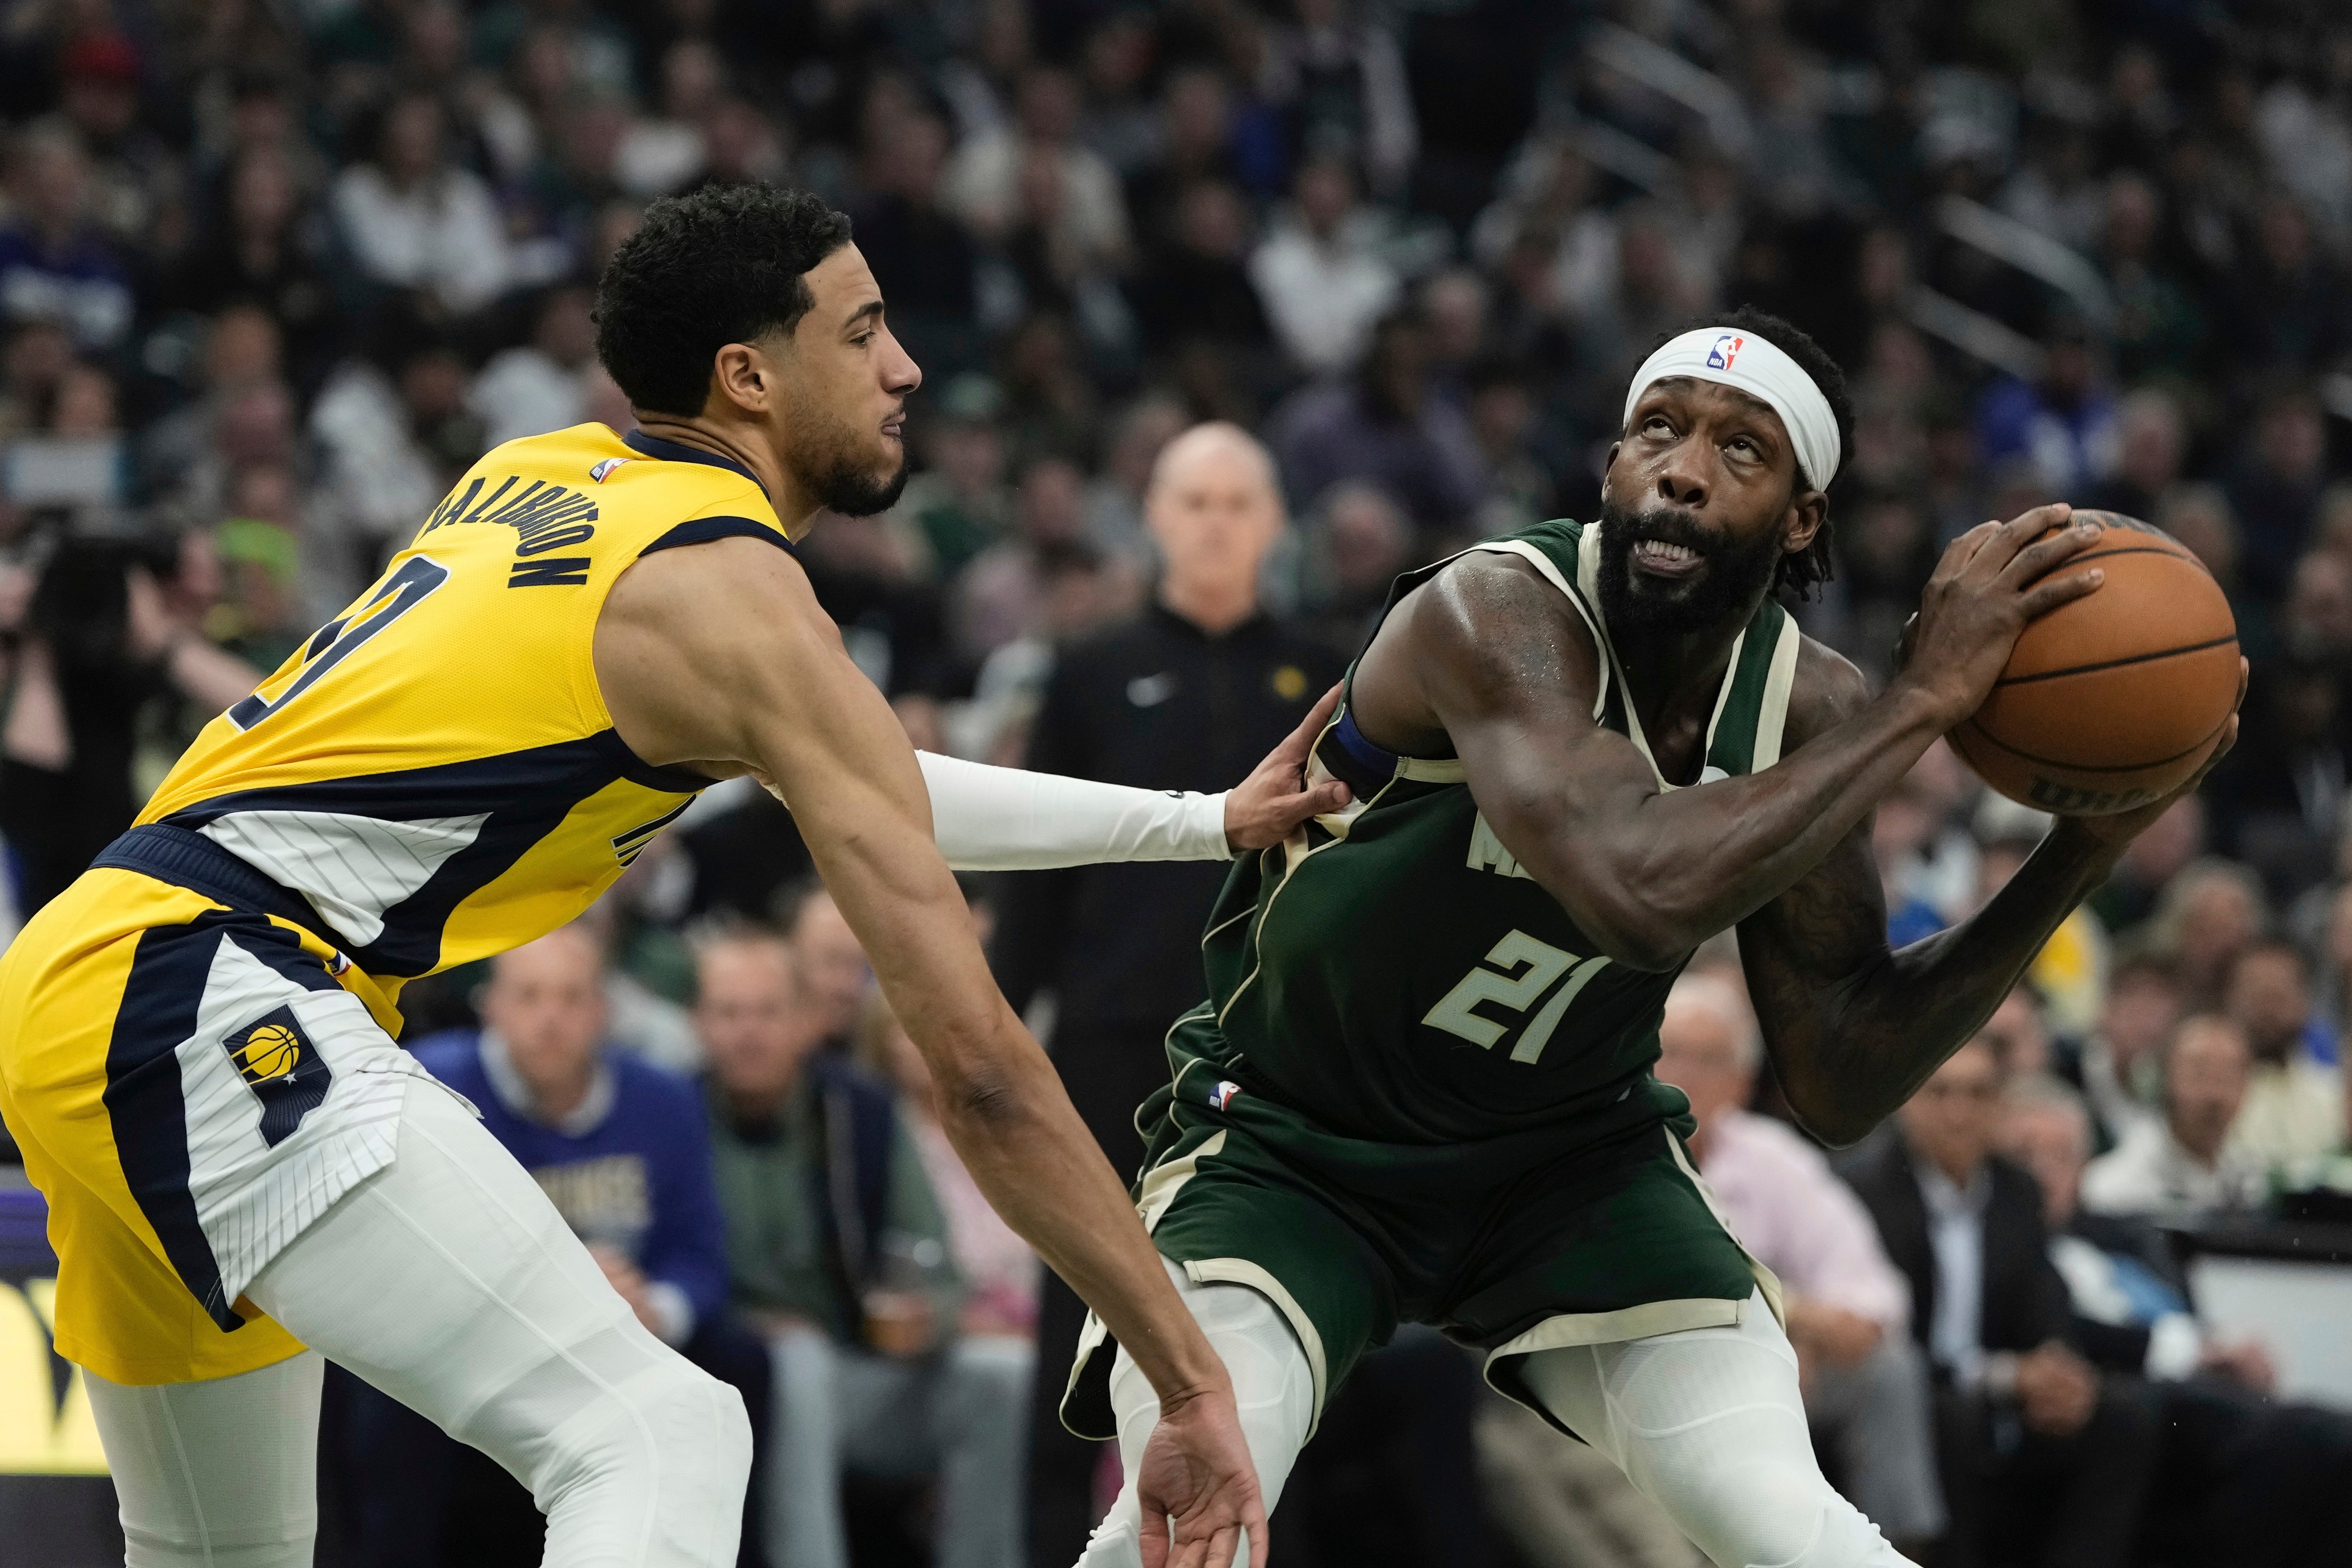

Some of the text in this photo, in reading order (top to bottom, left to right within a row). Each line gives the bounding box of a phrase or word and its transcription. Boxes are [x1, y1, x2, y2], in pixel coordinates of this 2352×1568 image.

[1709, 357, 1723, 367] NBA
[591, 466, 603, 479] NBA
[1421, 928, 1613, 1065] 21
